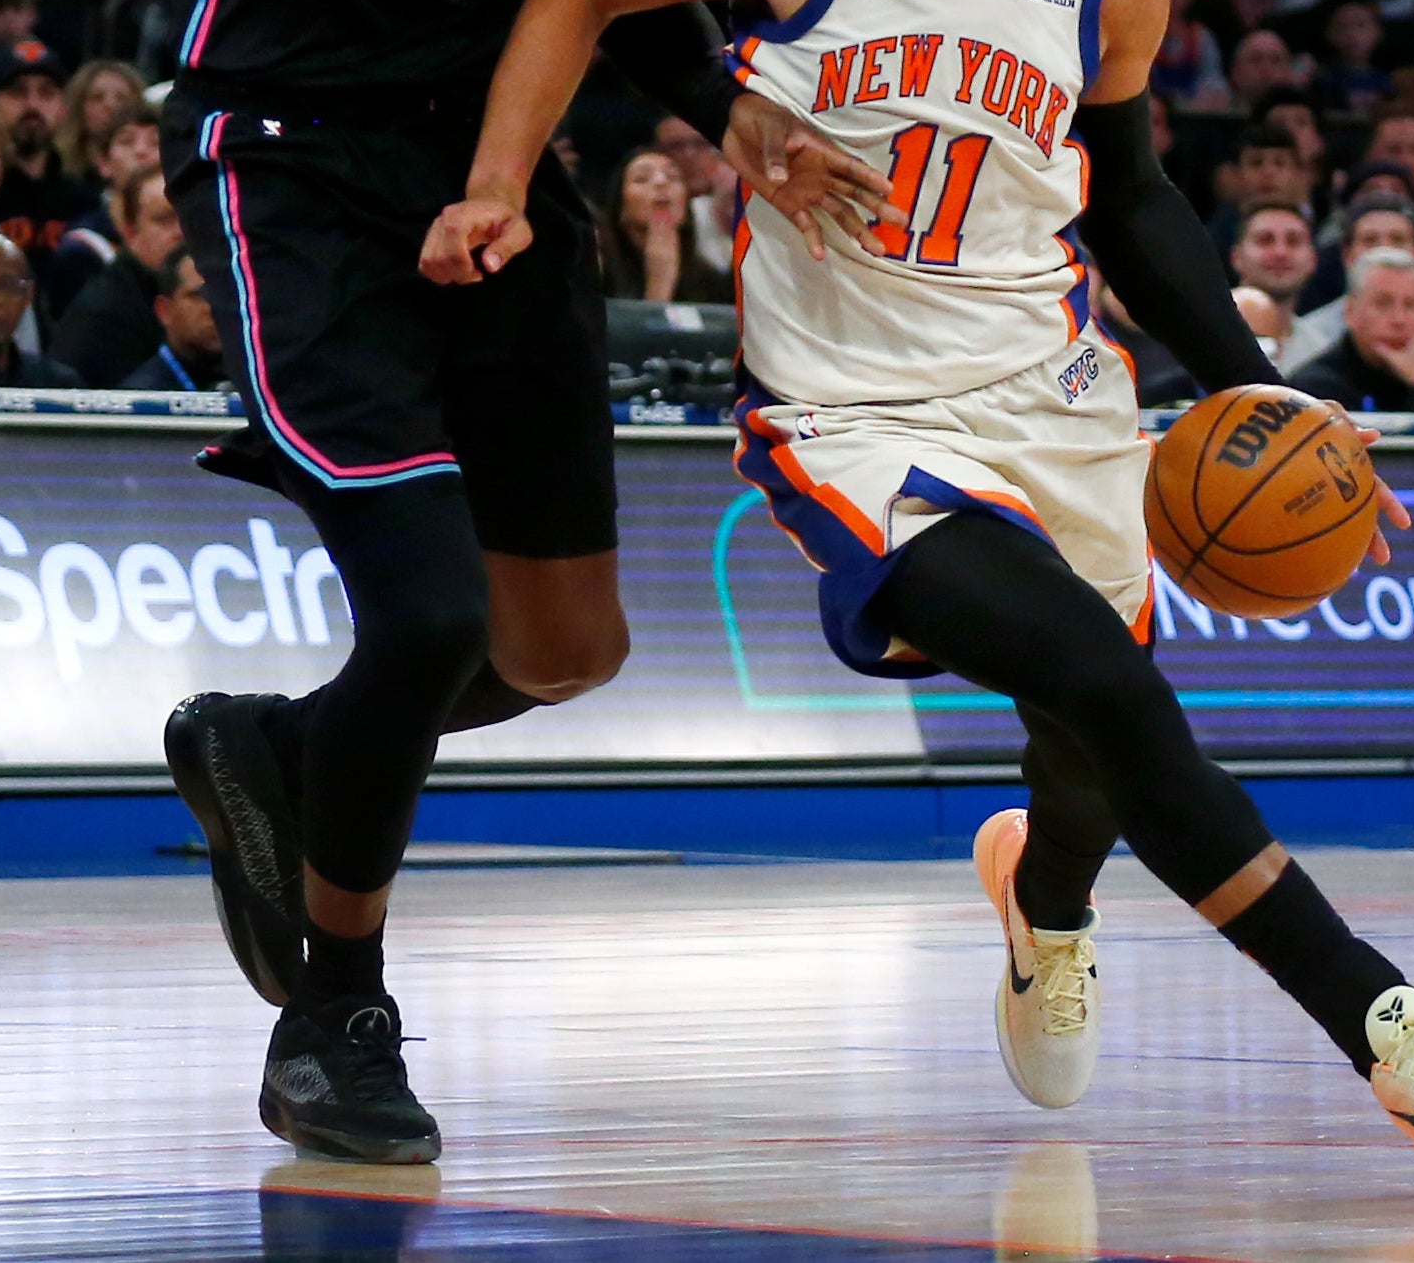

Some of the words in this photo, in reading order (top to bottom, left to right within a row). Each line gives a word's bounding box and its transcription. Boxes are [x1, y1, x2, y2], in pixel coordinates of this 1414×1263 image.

[812, 34, 944, 113] NEW
[955, 37, 1070, 160] YORK
[868, 121, 994, 267] 11
[1058, 348, 1099, 404] NYC
[1215, 393, 1310, 469] Wils
